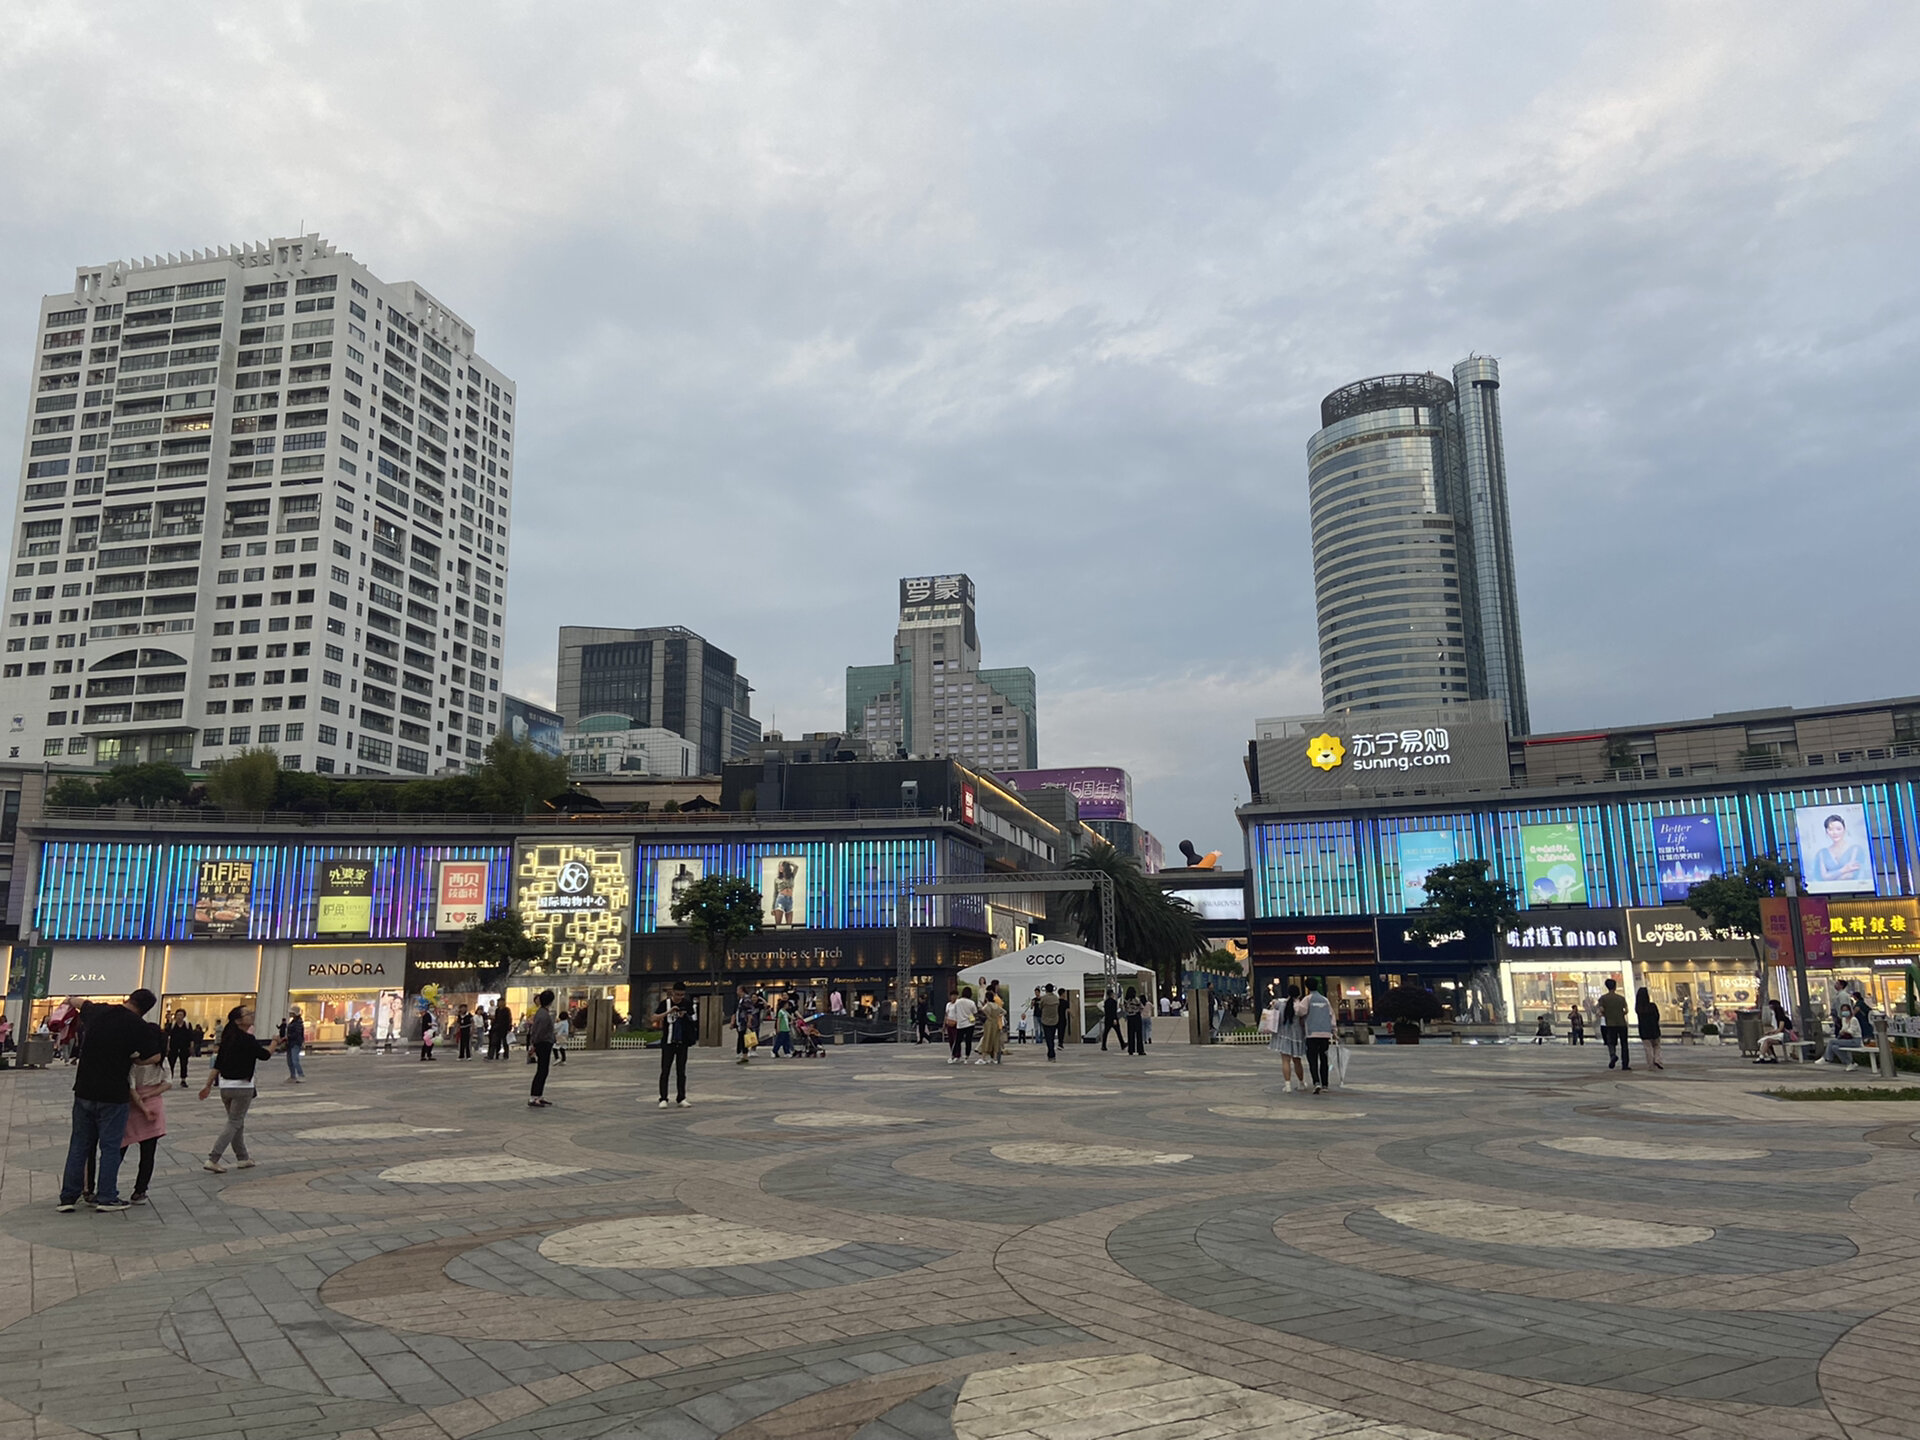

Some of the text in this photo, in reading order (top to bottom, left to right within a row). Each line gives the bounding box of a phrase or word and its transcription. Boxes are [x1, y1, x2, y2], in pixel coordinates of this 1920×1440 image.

[906, 576, 960, 603] 罗蒙
[1352, 728, 1449, 756] 苏宁易购
[1353, 754, 1451, 770] suning.com
[1660, 824, 1692, 833] Better
[1667, 832, 1687, 845] Life
[329, 866, 368, 881] 外婆家
[448, 872, 479, 887] 西贝
[540, 895, 607, 907] 国际购物中心
[1636, 923, 1697, 947] Leysen
[727, 946, 843, 960] Abercrombie & Fitch
[1295, 946, 1330, 955] TUDOR
[415, 961, 465, 969] VICTORIA'S
[1026, 954, 1065, 965] ecco
[308, 962, 385, 976] PANDORA
